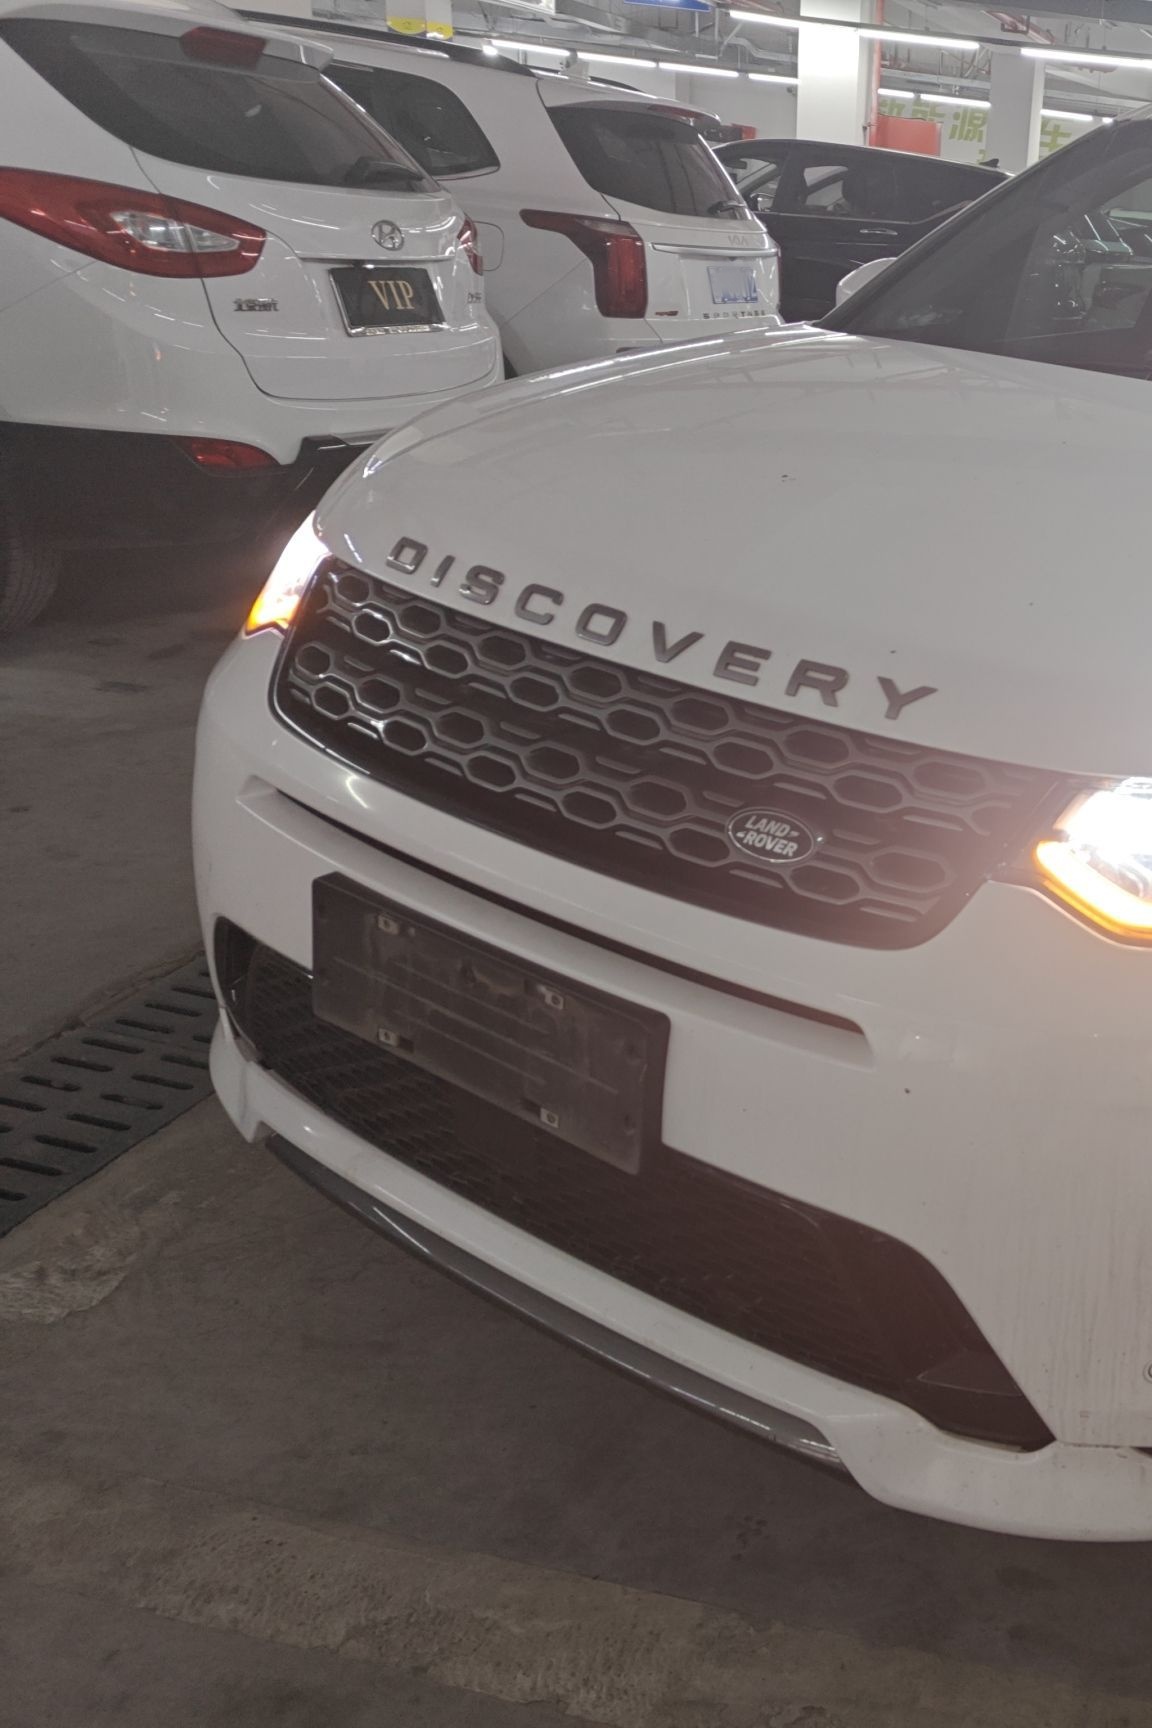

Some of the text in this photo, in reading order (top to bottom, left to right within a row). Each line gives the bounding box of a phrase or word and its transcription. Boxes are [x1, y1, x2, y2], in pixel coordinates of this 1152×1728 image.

[367, 280, 416, 310] VIP
[385, 536, 938, 721] DISCOVERY
[744, 815, 791, 837] LAND
[742, 830, 799, 857] ROVER
